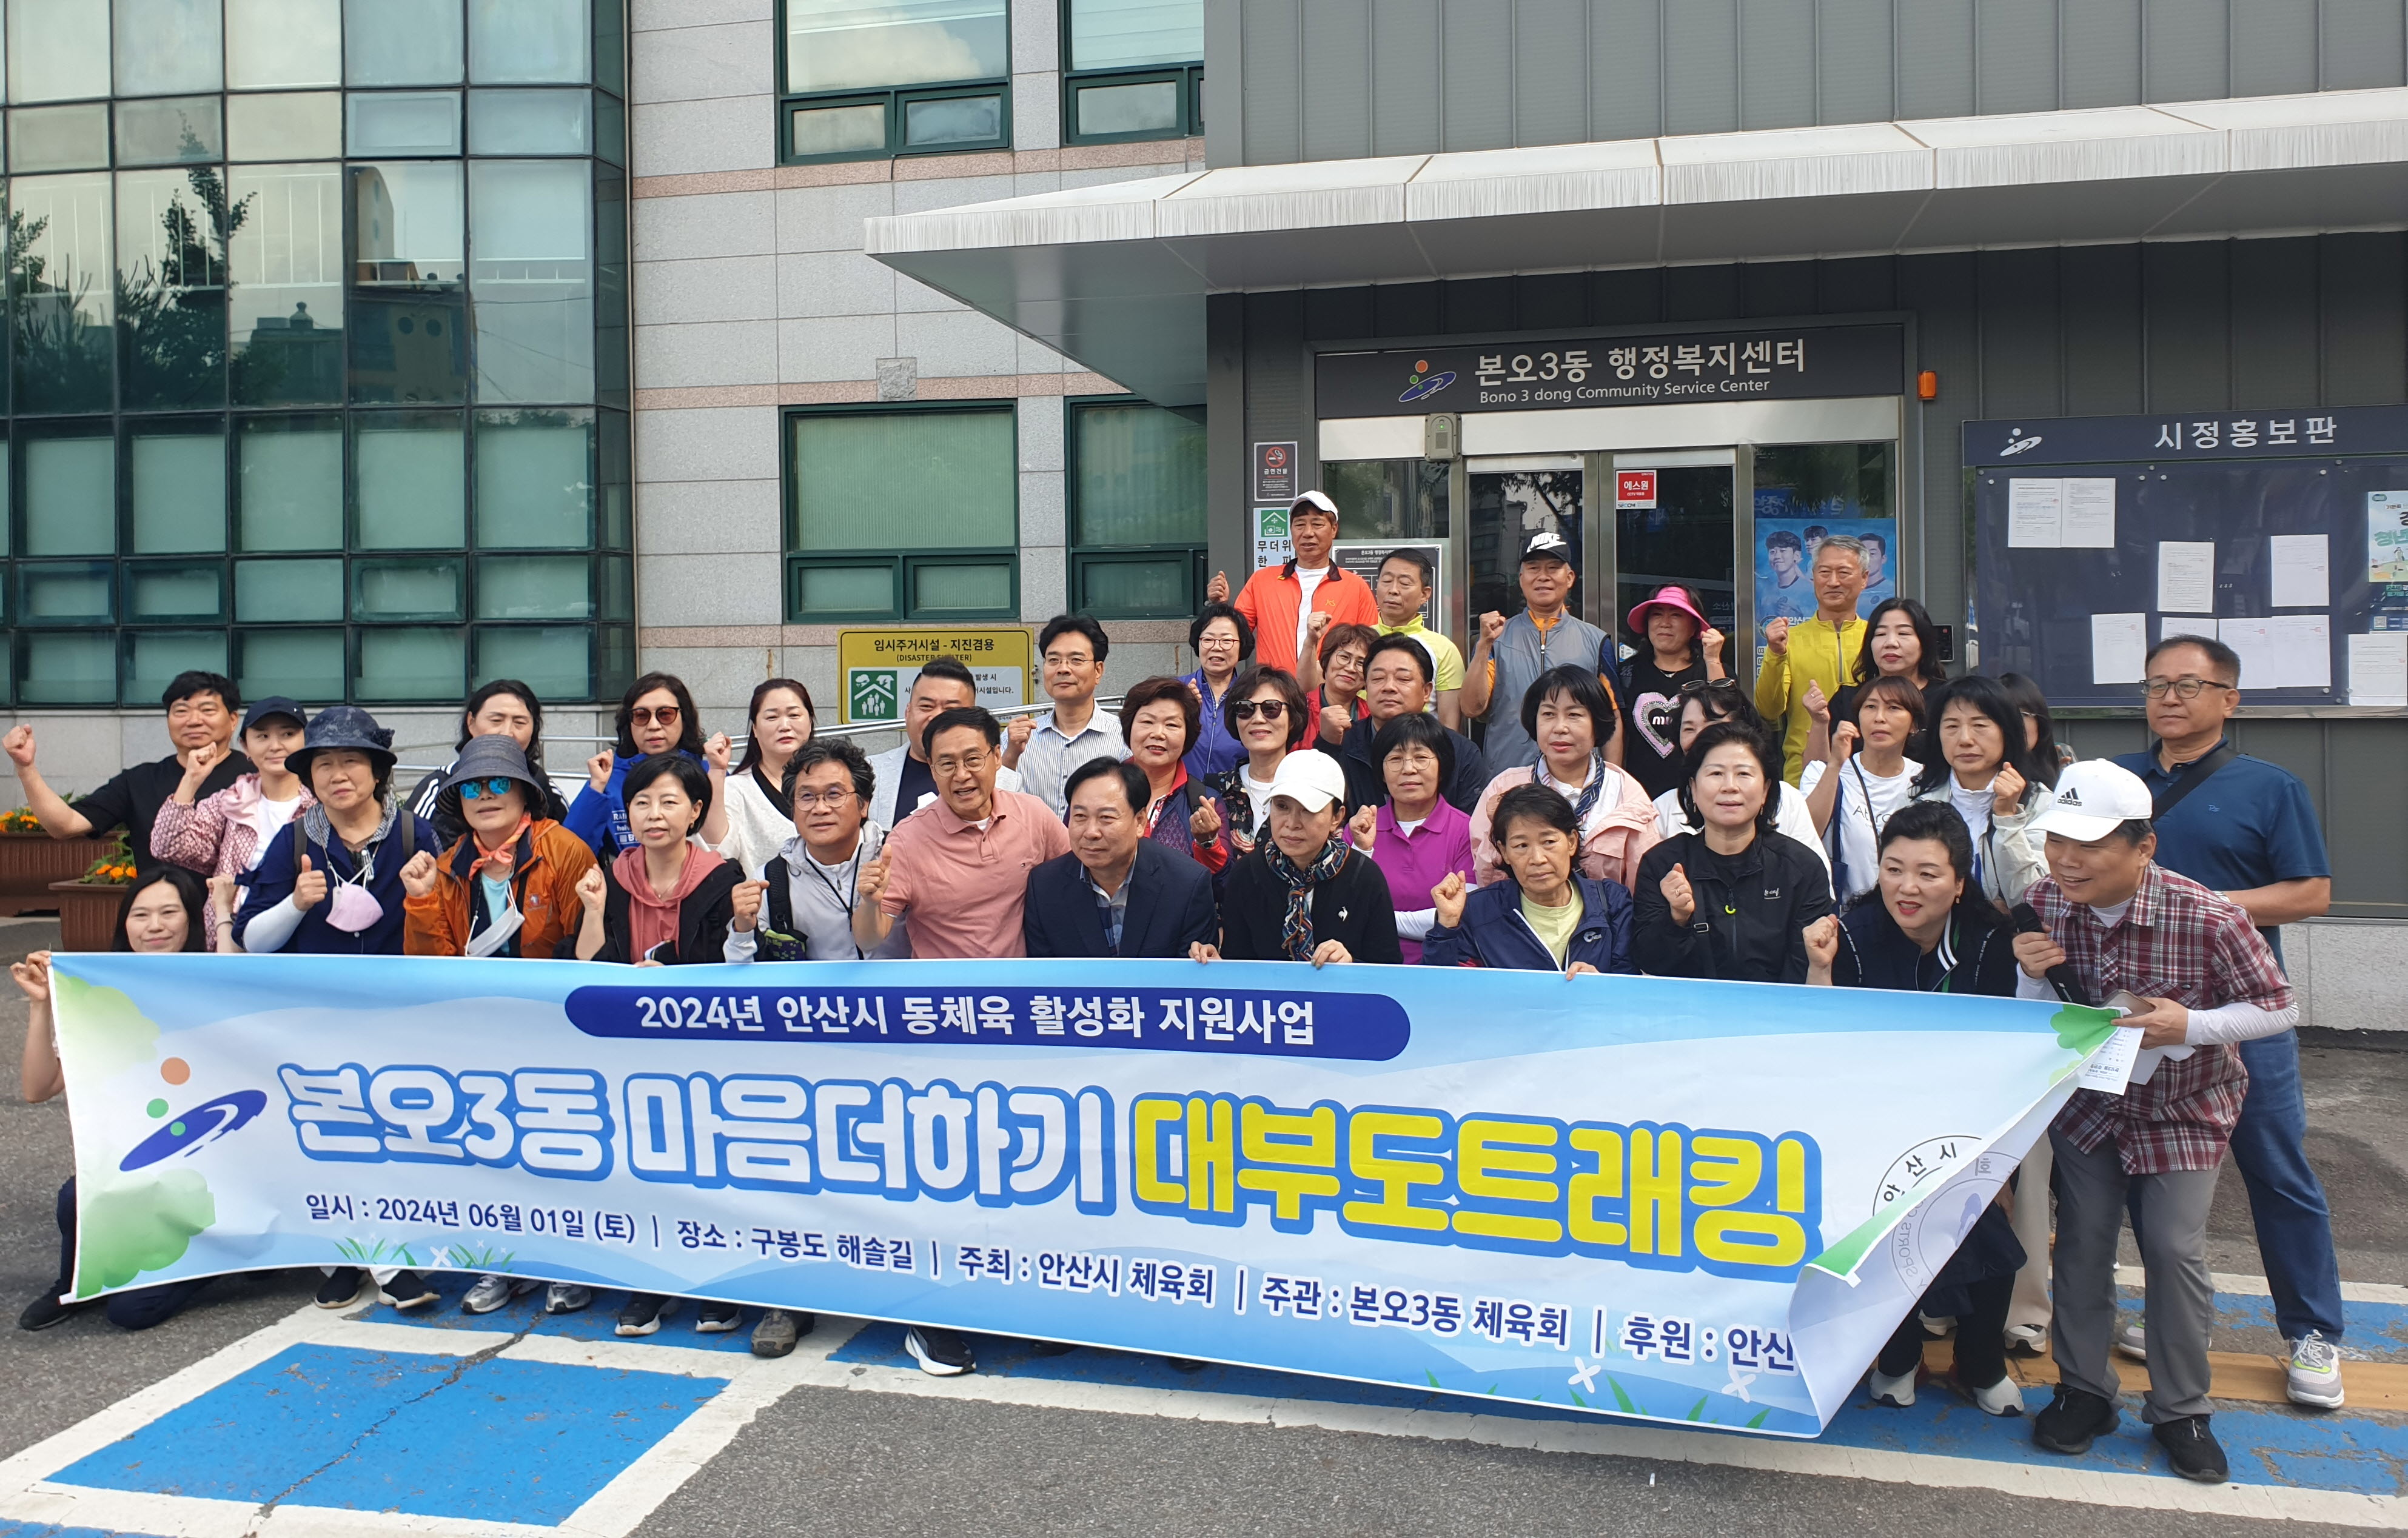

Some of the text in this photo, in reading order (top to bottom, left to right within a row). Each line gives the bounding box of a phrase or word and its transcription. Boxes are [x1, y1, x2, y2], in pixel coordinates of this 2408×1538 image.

[1475, 338, 1804, 386] 본오3동 행정복지센터
[1480, 379, 1770, 403] Bono 3 dong Community Service Center
[2155, 416, 2337, 450] 시정홍보판
[1624, 480, 1648, 490] 에스원
[1258, 540, 1291, 552] 무더위
[1530, 532, 1560, 549] NIKE
[874, 639, 939, 652] 임시주거시설
[950, 638, 994, 651] 지진겸용
[636, 995, 1315, 1045] 2024년 안산시 동체육 활성화 지원사업
[279, 1063, 1822, 1282] 본오3동 마음더하기 대부도트래킹
[306, 1194, 355, 1222] 일시
[378, 1198, 460, 1228] 2024년
[468, 1203, 523, 1232] 06월
[530, 1207, 584, 1239] 01일
[595, 1210, 635, 1243] (토)
[676, 1219, 728, 1250] 장소
[751, 1225, 828, 1260] 구봉도
[836, 1233, 913, 1271] 해솔길
[958, 1246, 1012, 1282] 주최
[1038, 1252, 1120, 1292] 안산시
[1130, 1260, 1214, 1304] 체육회
[1262, 1276, 1323, 1316] 주관
[1350, 1285, 1461, 1333] 본오3동
[1472, 1298, 1569, 1347] 체육회
[1624, 1314, 1692, 1361] 후원
